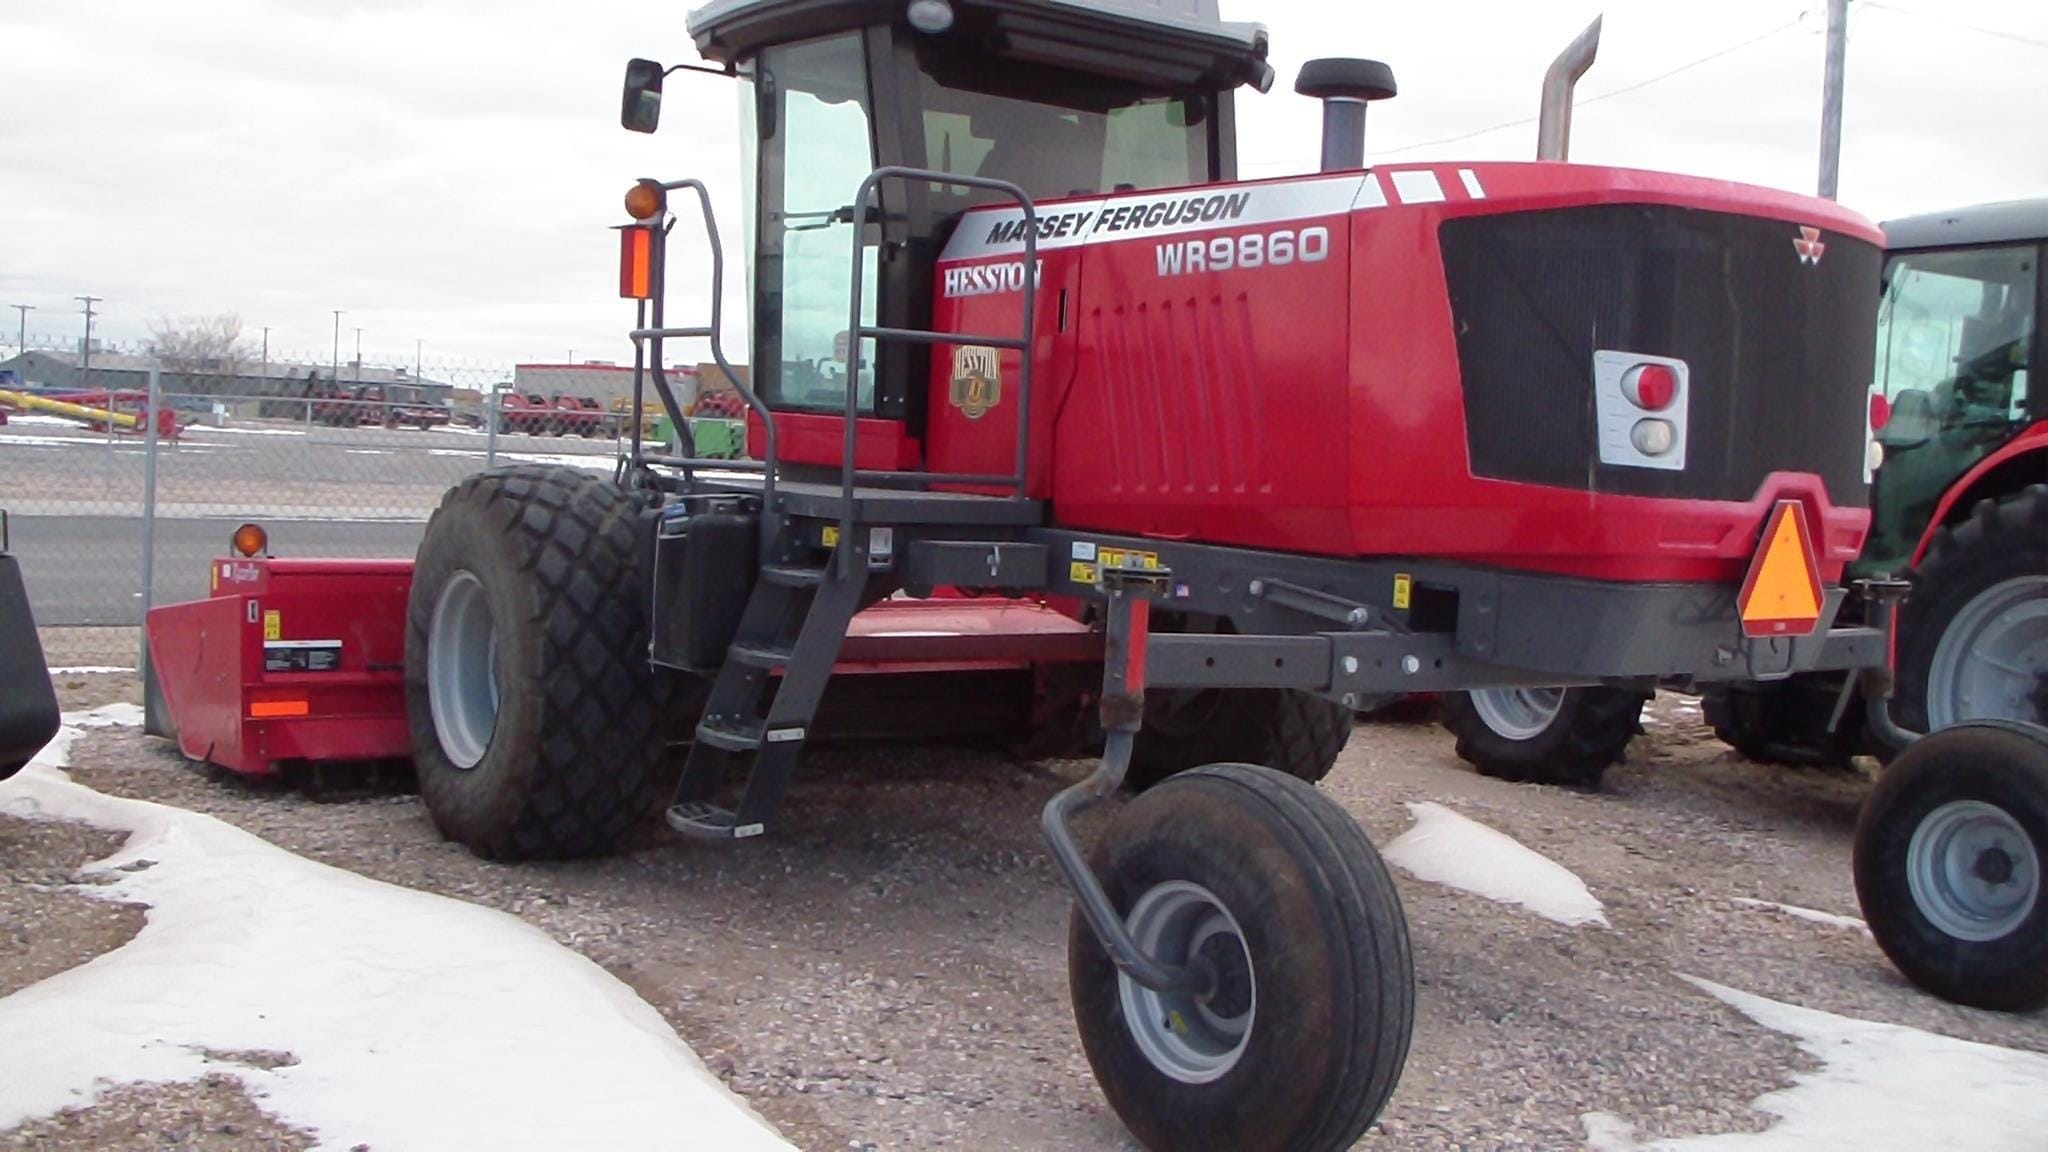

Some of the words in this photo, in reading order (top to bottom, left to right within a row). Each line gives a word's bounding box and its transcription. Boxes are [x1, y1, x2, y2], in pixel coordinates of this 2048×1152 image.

[1092, 192, 1250, 233] FERGUSON
[1156, 227, 1328, 276] WR9860
[944, 260, 1043, 297] HESSTON
